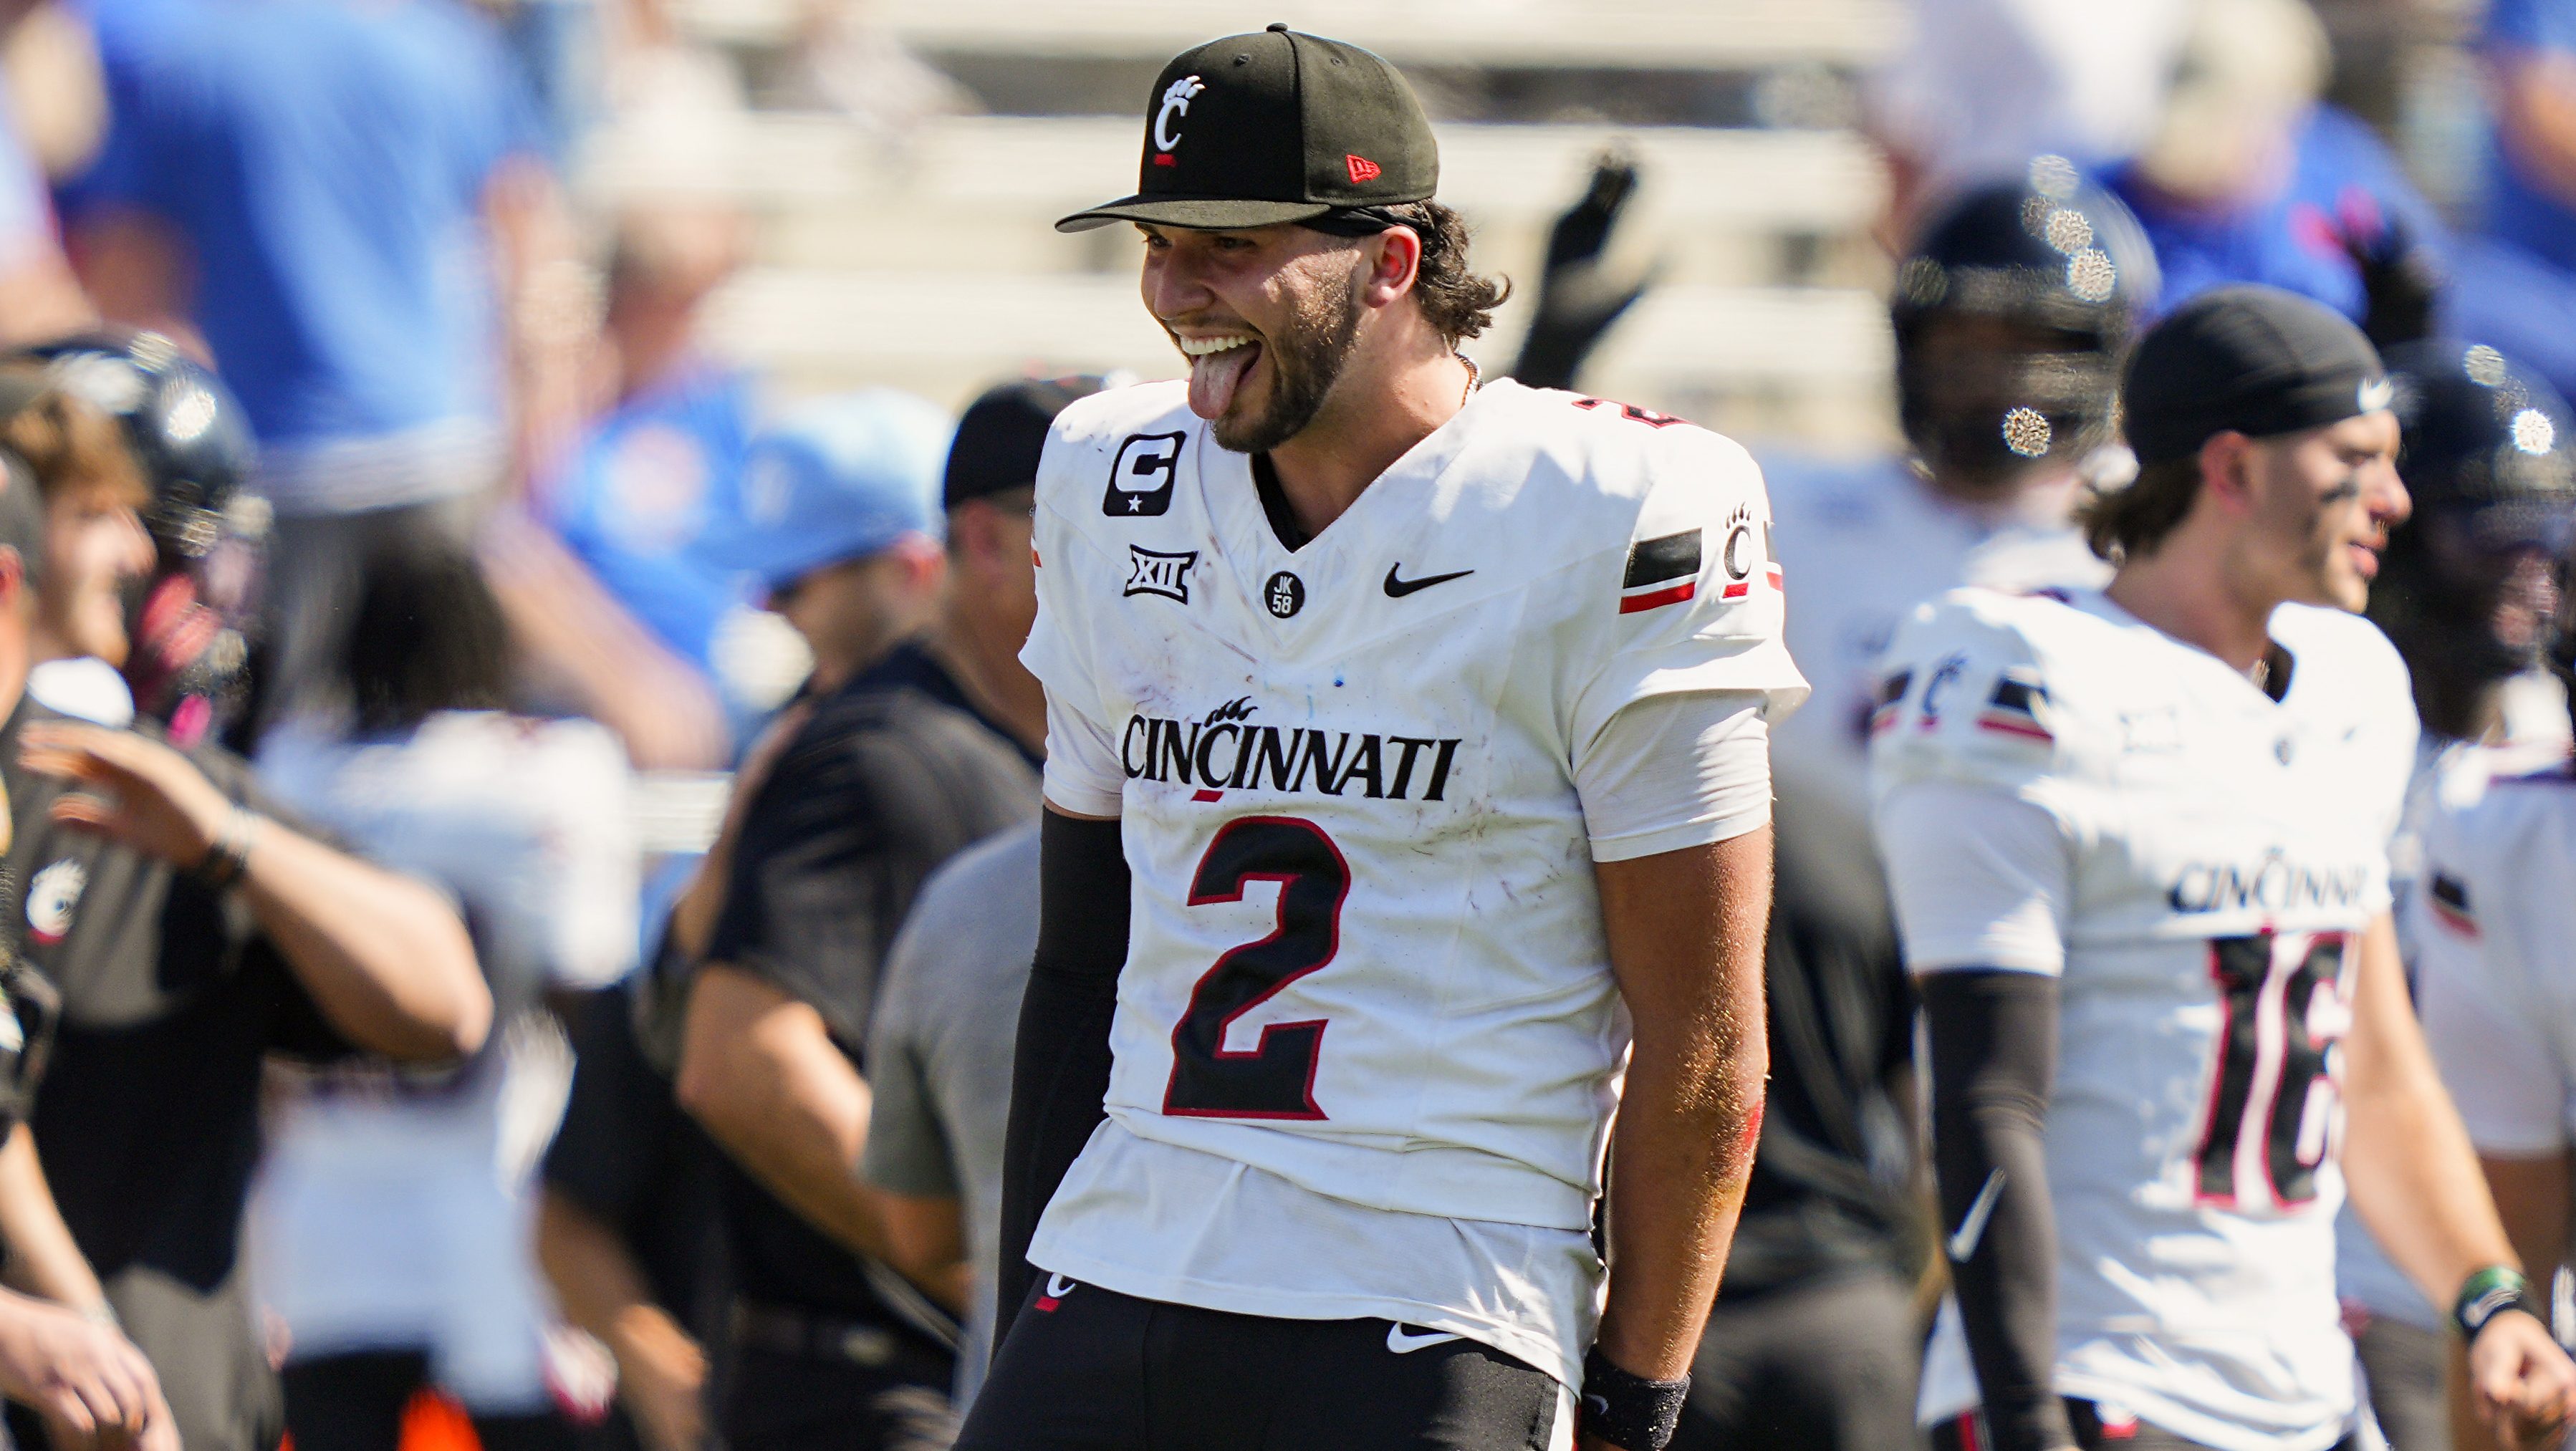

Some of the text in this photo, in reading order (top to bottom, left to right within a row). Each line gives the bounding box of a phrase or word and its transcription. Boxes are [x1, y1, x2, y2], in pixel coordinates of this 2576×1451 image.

[1115, 436, 1176, 493] C
[1272, 594, 1292, 614] 58
[1274, 576, 1294, 595] JK
[1122, 713, 1463, 801] CINCINNATI
[1163, 815, 1351, 1121] 2
